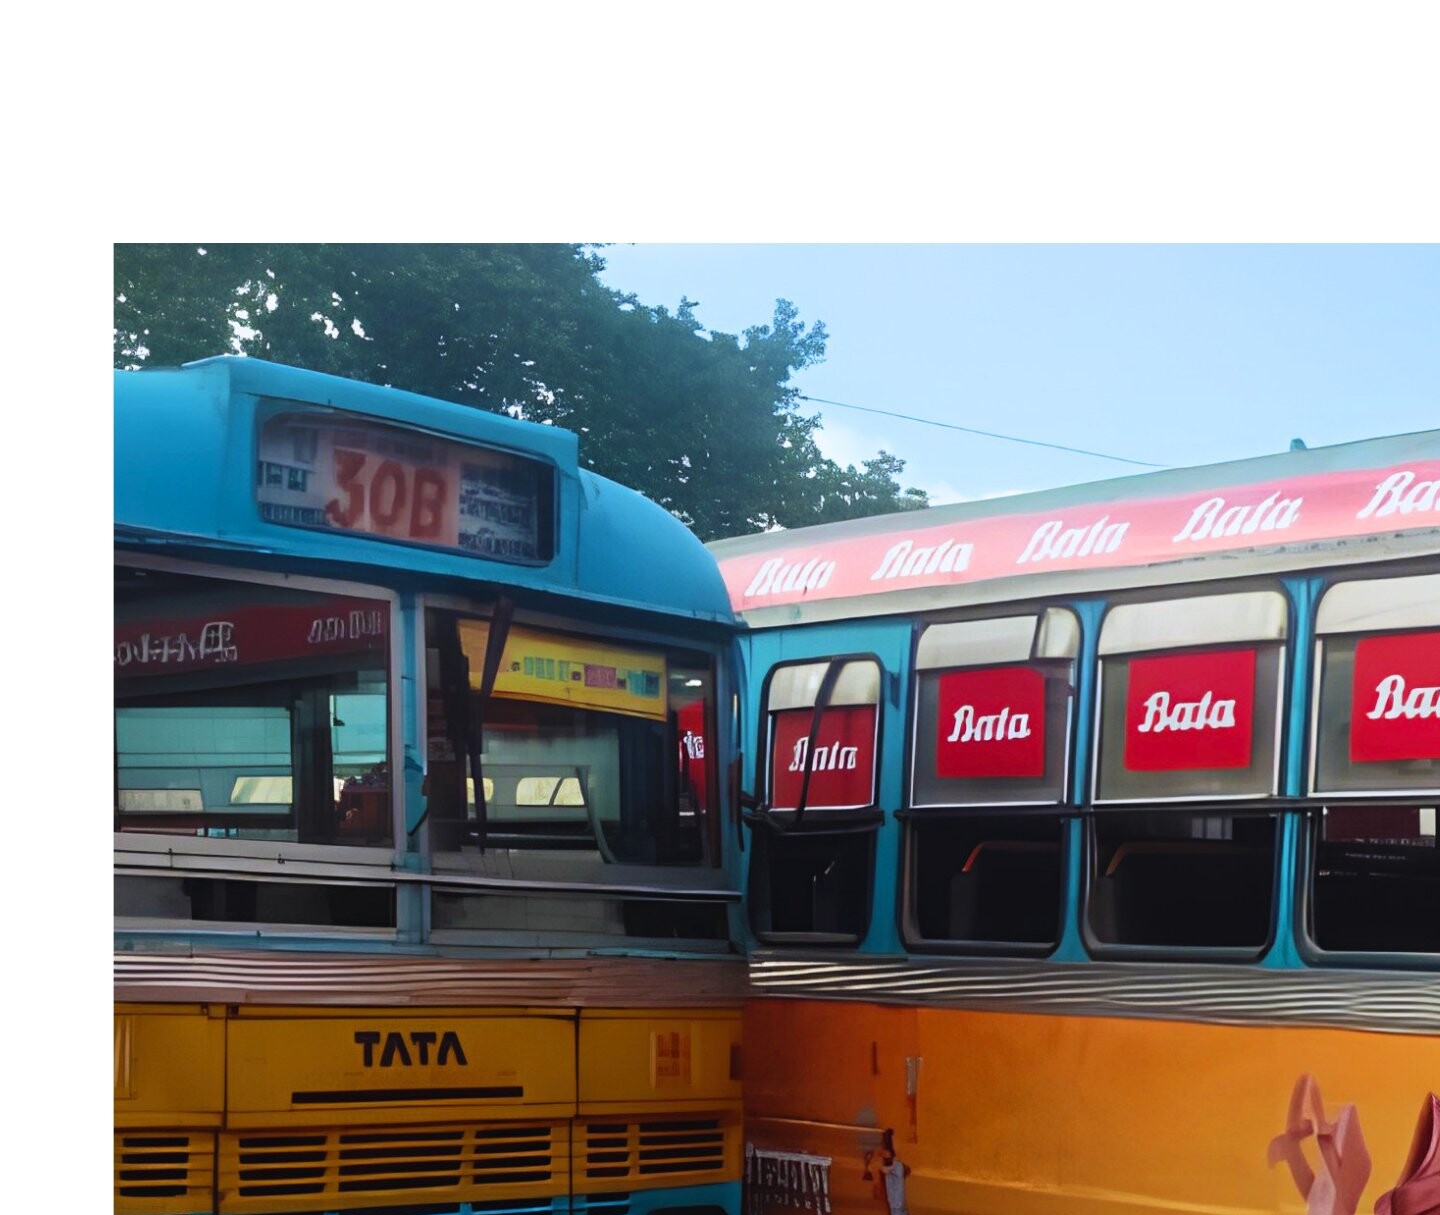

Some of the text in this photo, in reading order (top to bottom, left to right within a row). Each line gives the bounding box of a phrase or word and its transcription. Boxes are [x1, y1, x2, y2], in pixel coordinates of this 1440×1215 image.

[325, 449, 446, 538] 30B
[1172, 490, 1303, 543] Bata
[1138, 691, 1236, 733] Bata
[354, 1031, 468, 1068] TATA
